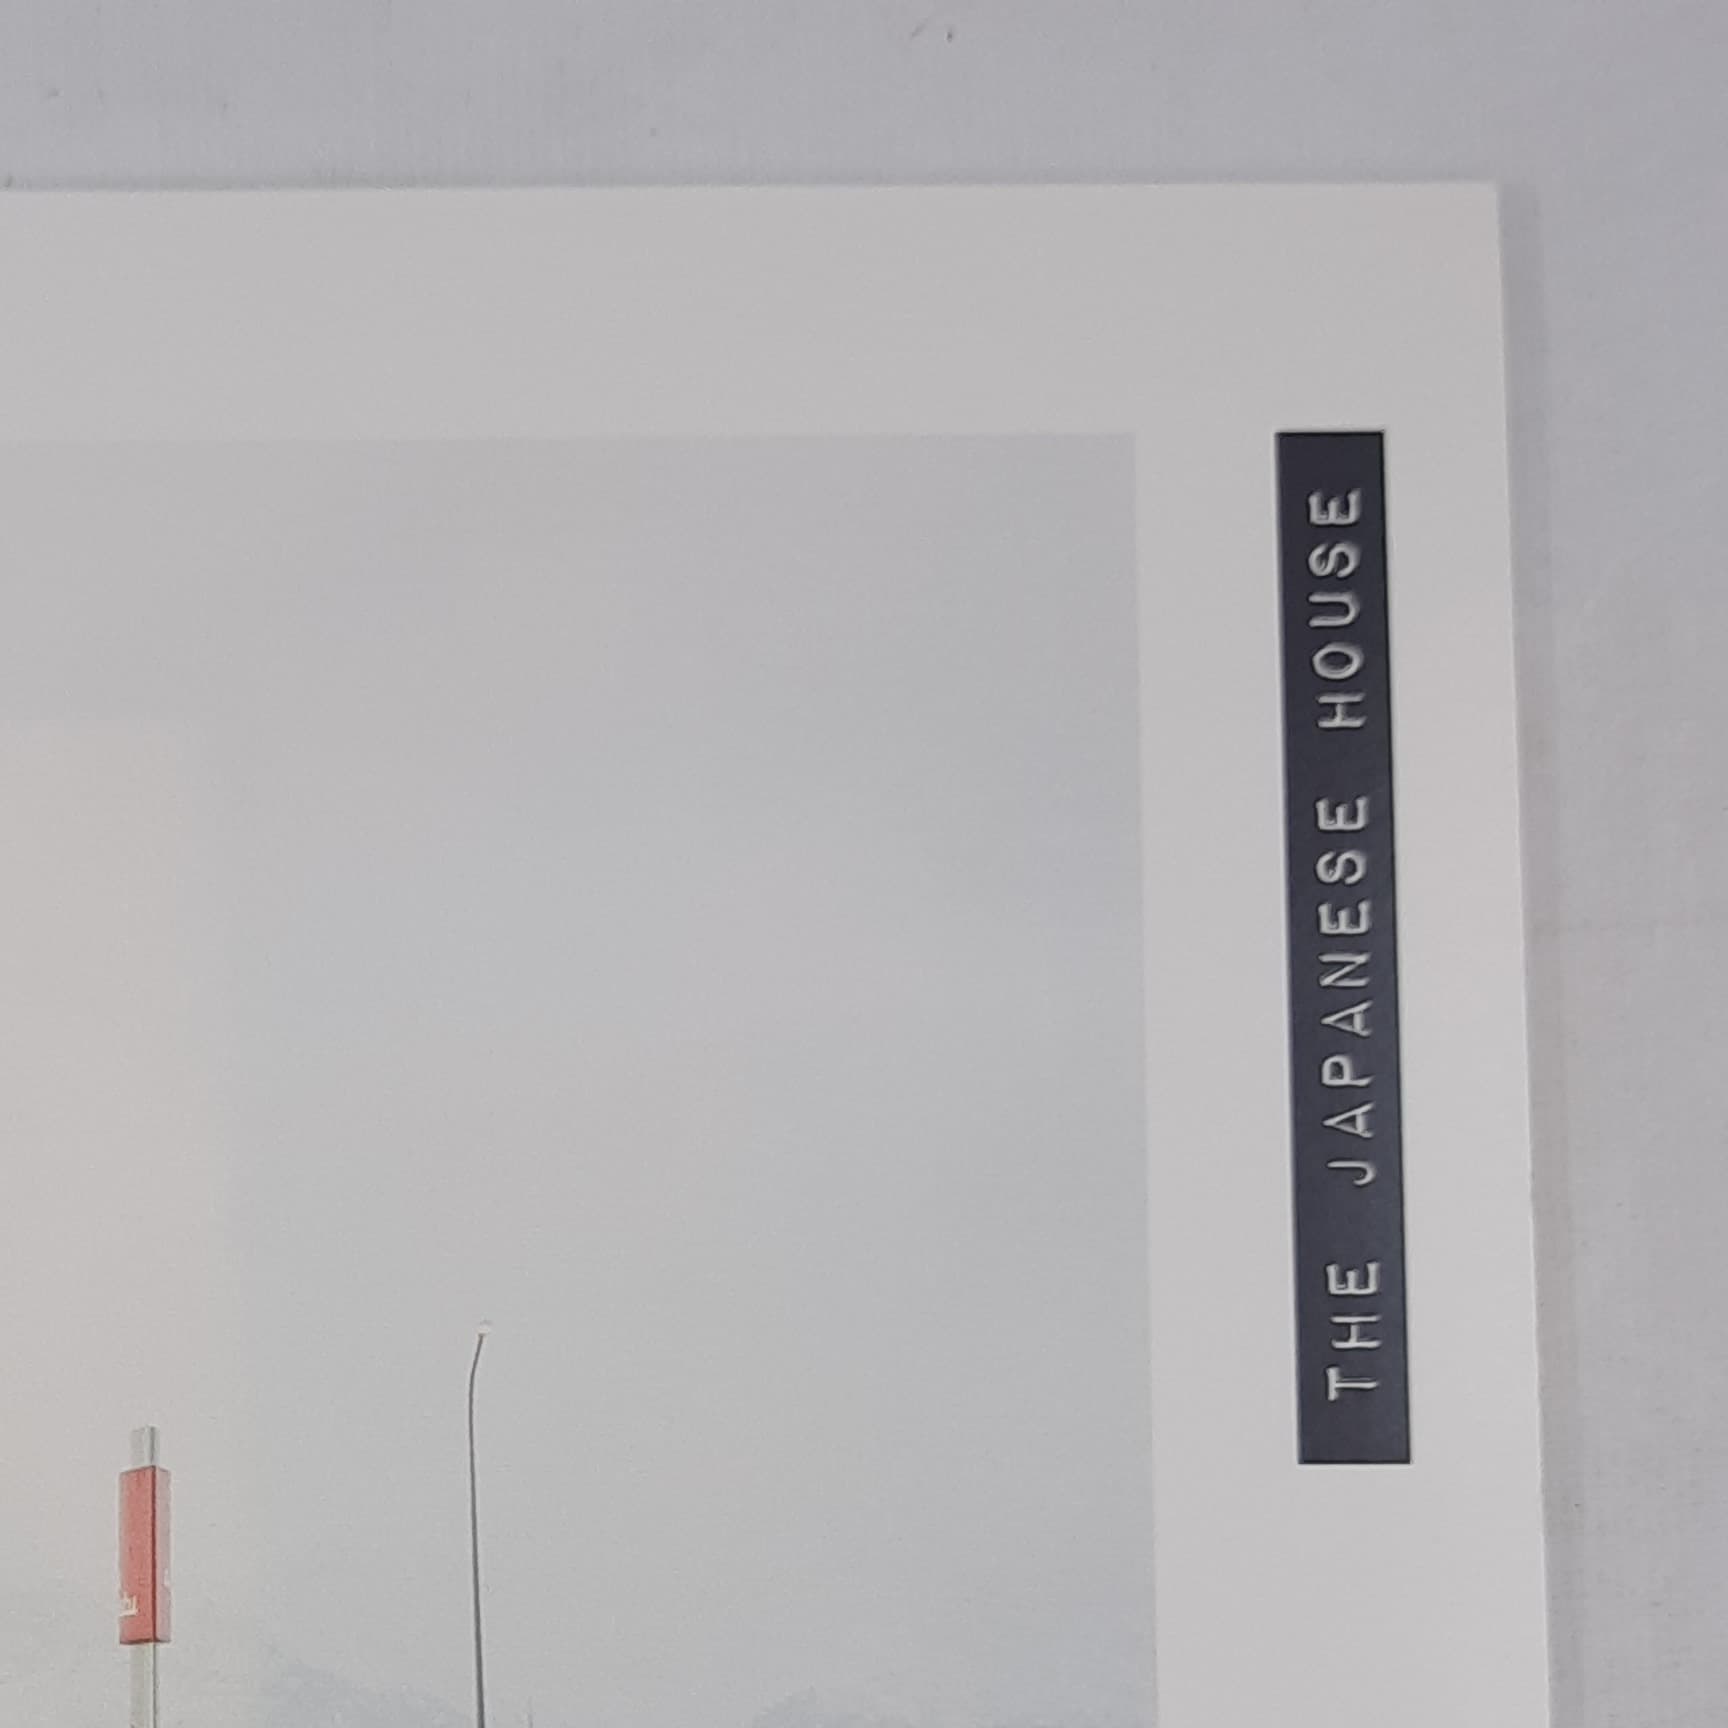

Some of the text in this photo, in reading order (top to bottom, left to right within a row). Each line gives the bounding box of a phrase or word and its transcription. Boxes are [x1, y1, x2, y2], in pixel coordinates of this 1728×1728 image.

[1306, 485, 1384, 1403] THE JAPANESE HOUSE
